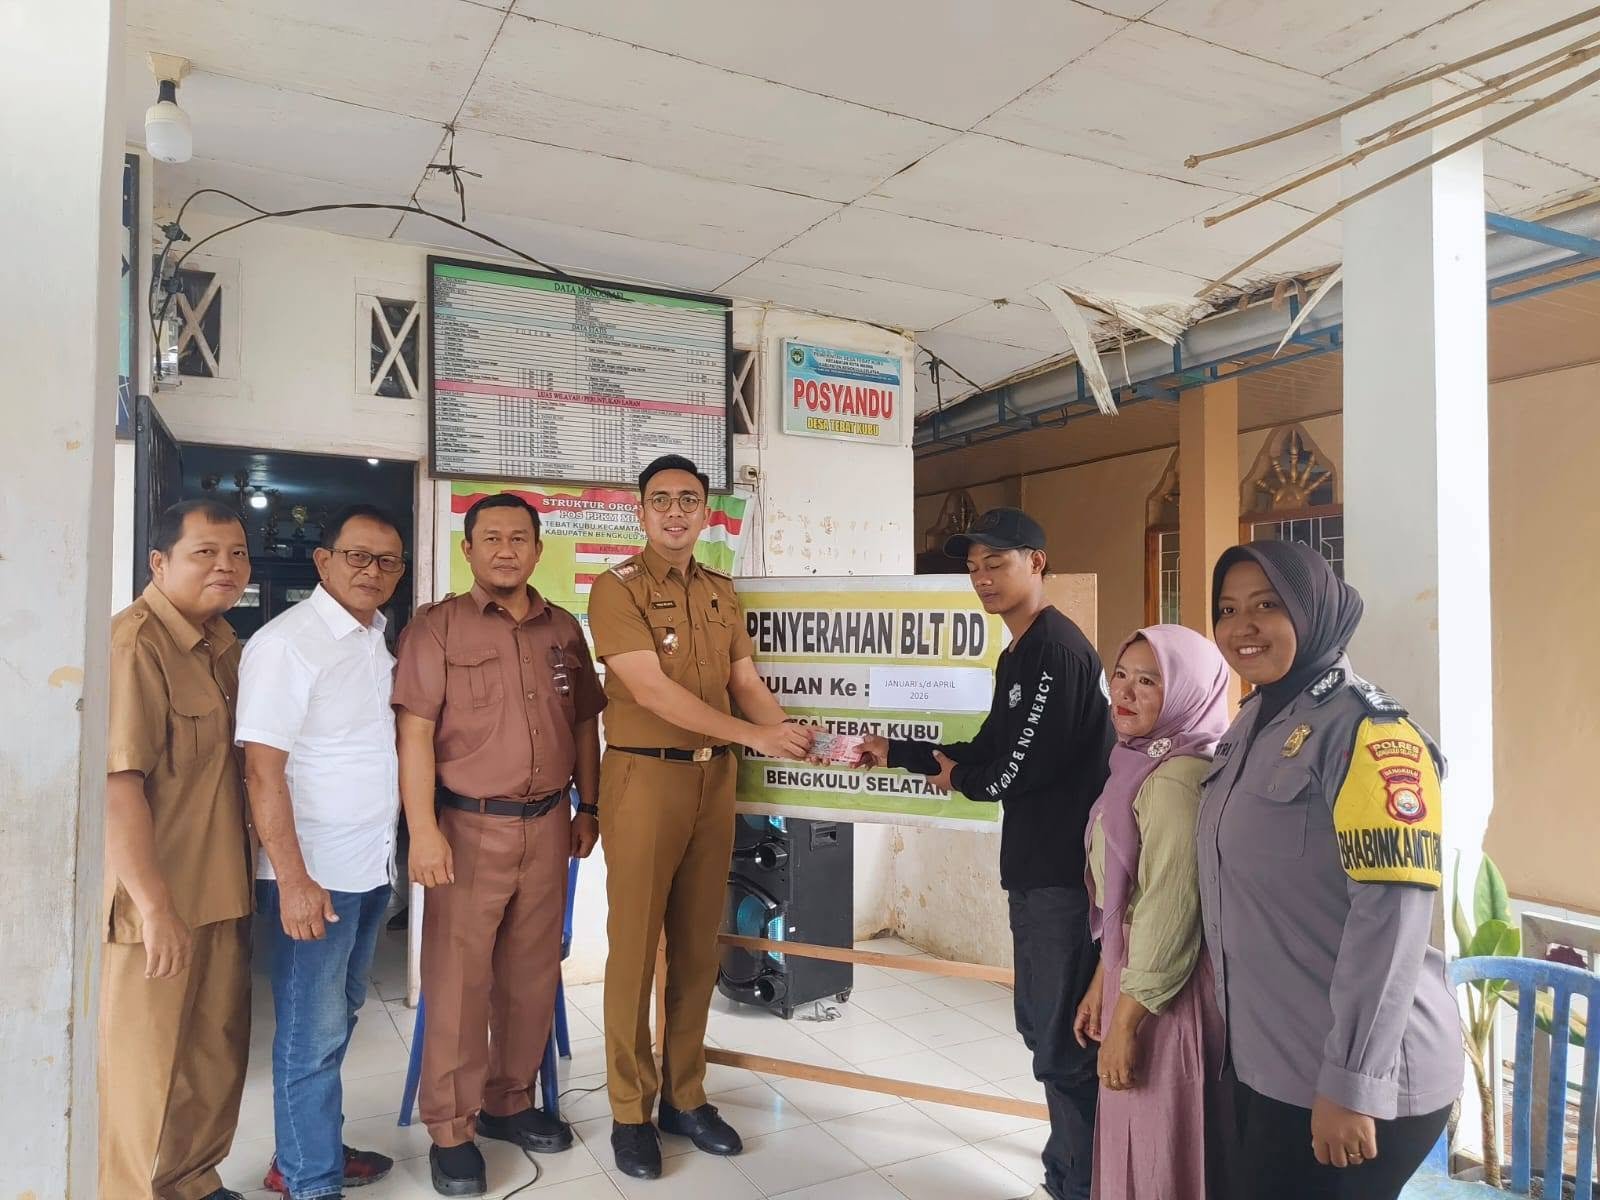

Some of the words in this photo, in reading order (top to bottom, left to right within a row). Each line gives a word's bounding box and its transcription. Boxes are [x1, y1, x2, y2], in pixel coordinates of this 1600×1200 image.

[554, 282, 576, 294] DATA
[793, 378, 893, 419] POSYANDU
[807, 417, 829, 431] DESA
[830, 419, 856, 434] TEBAT
[856, 421, 880, 436] KUBU
[542, 498, 607, 510] STRUKTUR
[560, 511, 583, 520] POS
[586, 511, 619, 521] PPKM
[545, 520, 572, 529] TEBAT
[573, 522, 597, 530] KUBU
[545, 529, 594, 538] KABUPATEN
[746, 611, 893, 655] PENYERAHAN
[901, 611, 944, 656] BLT
[952, 613, 985, 657] DD
[760, 676, 822, 695] ULAN
[830, 677, 857, 698] Ke
[884, 680, 917, 688] JANUARI
[919, 679, 931, 689] s/d
[933, 680, 956, 689] APRIL
[910, 692, 929, 700] 2026
[1027, 670, 1054, 725] MERCY
[825, 720, 881, 737] TEBAT
[887, 723, 939, 740] KUBU
[1017, 727, 1035, 748] NO
[1372, 740, 1419, 755] POLRES
[1012, 751, 1025, 760] &
[766, 770, 860, 790] BENGKULU
